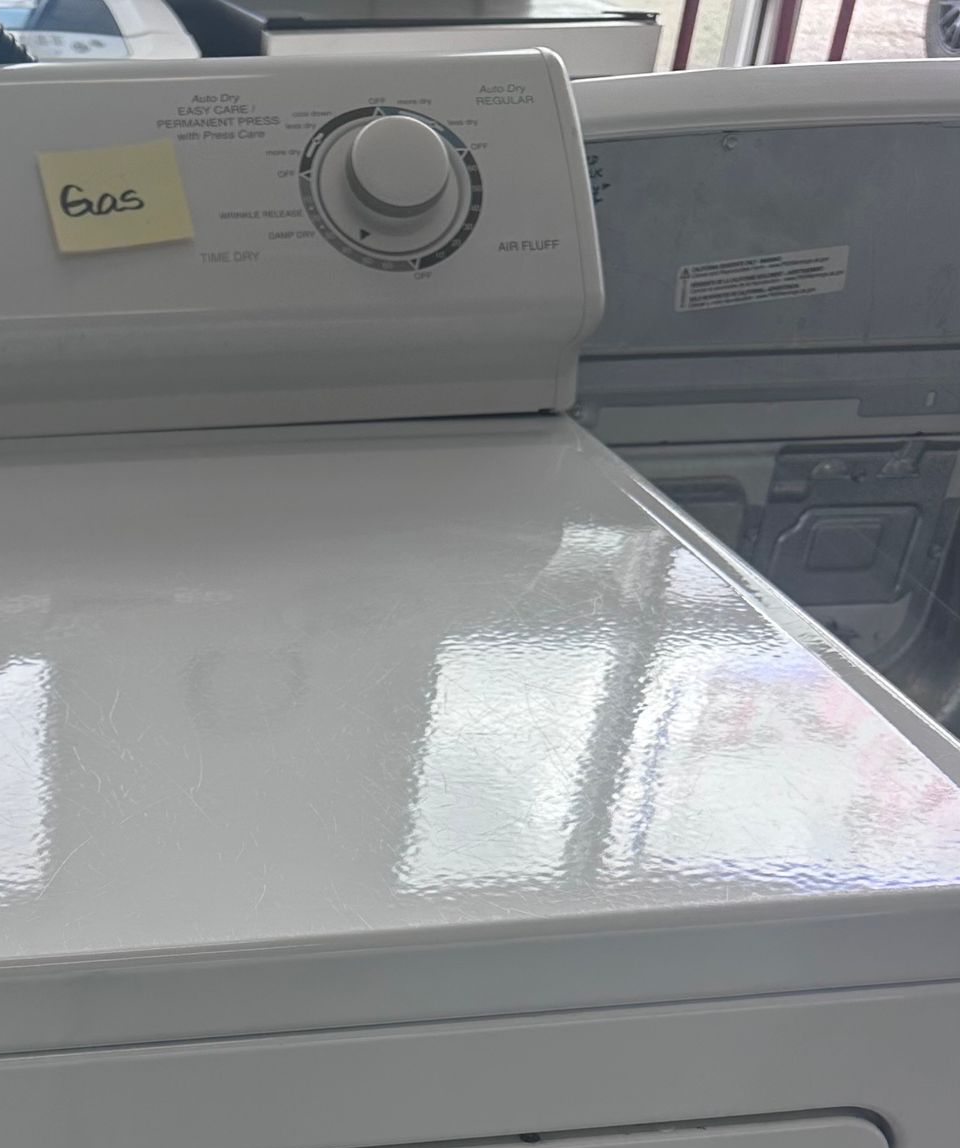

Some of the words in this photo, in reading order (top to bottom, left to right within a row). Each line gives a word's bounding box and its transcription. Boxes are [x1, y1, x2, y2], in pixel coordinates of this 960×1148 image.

[480, 85, 504, 94] Auto
[507, 83, 526, 95] Dry
[192, 94, 216, 103] Auto
[220, 93, 240, 104] Dry
[476, 95, 535, 106] REGULAR
[177, 106, 211, 116] EASY
[214, 105, 249, 115] CARE
[156, 118, 236, 129] PERMANENT
[238, 115, 280, 127] PRESS
[177, 132, 200, 142] with
[203, 130, 235, 140] Press
[239, 129, 266, 139] Care
[60, 184, 145, 217] Gas
[219, 210, 261, 220] WRINKLE
[262, 209, 304, 219] RELEASE
[296, 230, 316, 239] DRY
[498, 241, 518, 252] AIR
[521, 239, 560, 251] FLUFF
[201, 252, 231, 264] TIME
[233, 251, 261, 263] DRY
